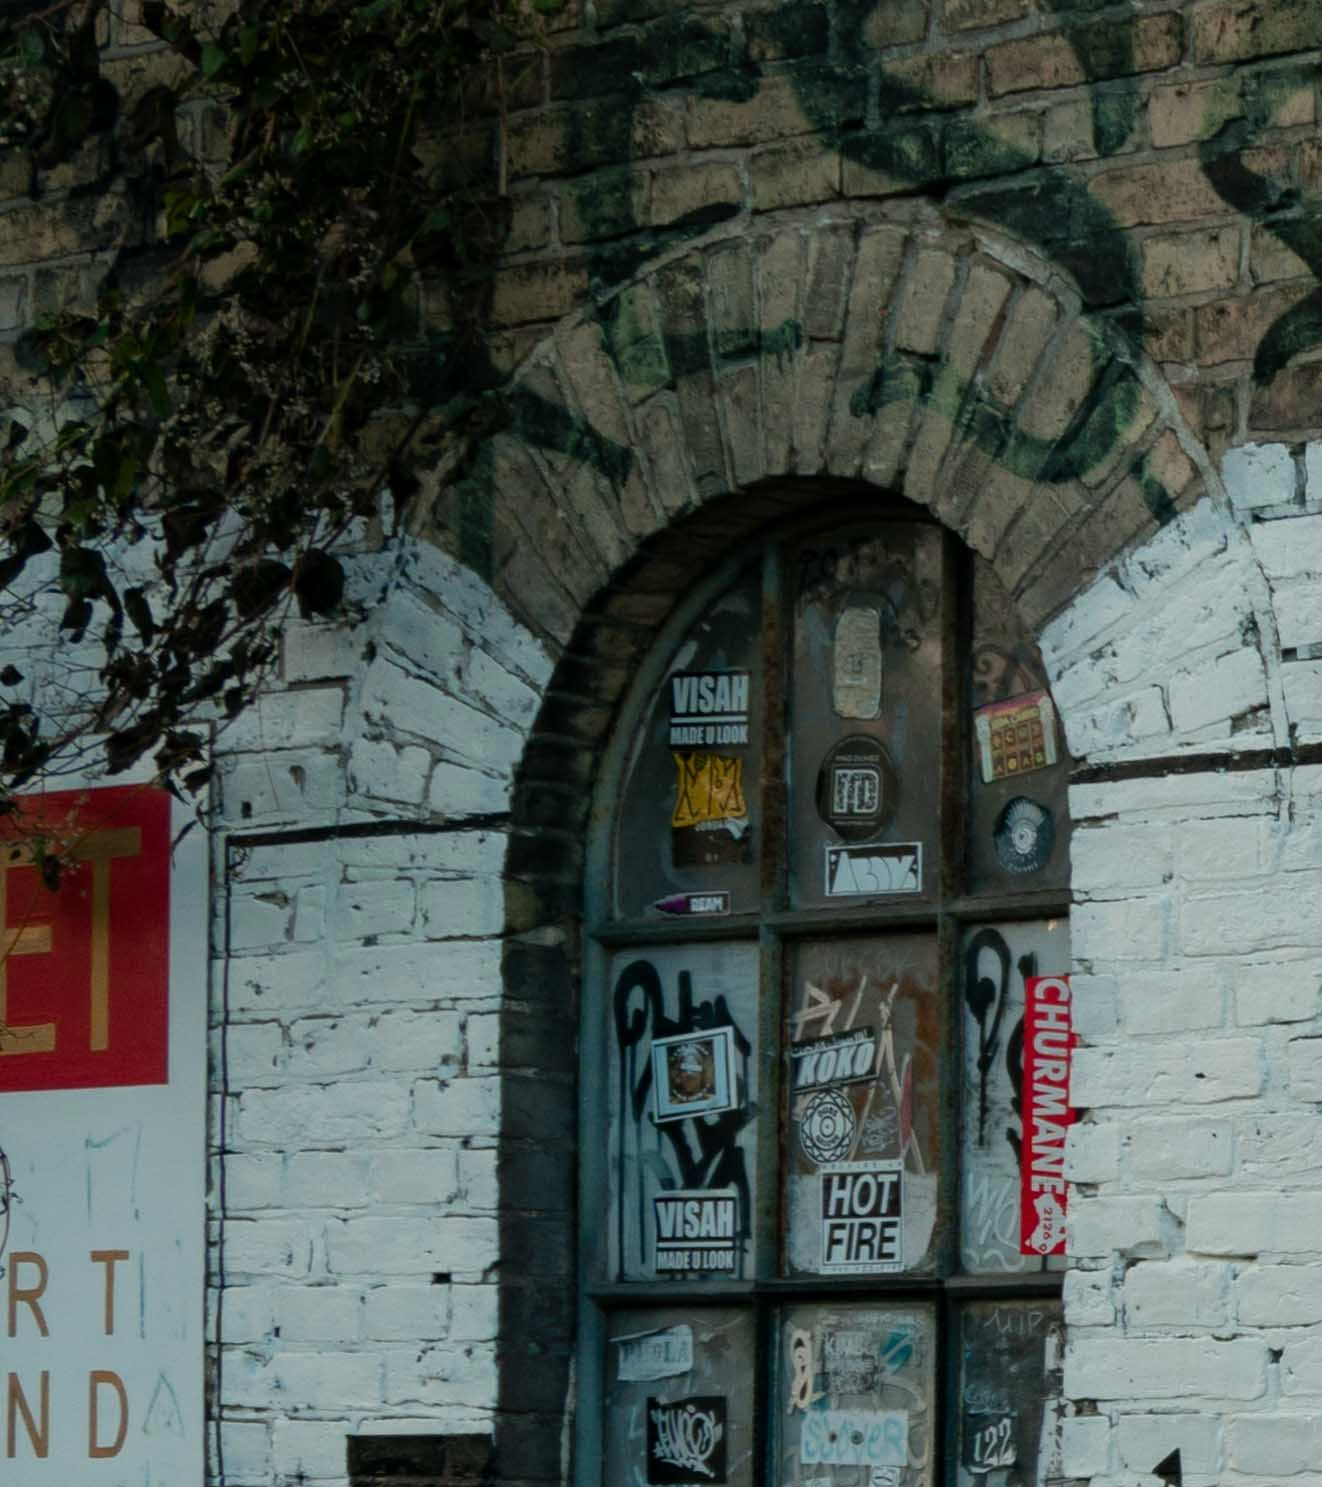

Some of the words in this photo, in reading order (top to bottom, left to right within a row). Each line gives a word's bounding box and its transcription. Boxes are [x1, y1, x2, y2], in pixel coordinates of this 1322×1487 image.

[672, 675, 750, 714] VISAH
[797, 1041, 876, 1087] KOKO
[1030, 978, 1071, 1196] CHURMANE
[828, 1173, 899, 1216] HOT
[655, 1200, 733, 1239] VISAH
[656, 1250, 691, 1270] MADE
[692, 1250, 701, 1270] U
[702, 1249, 735, 1270] LOOK
[826, 1220, 899, 1262] FIRE
